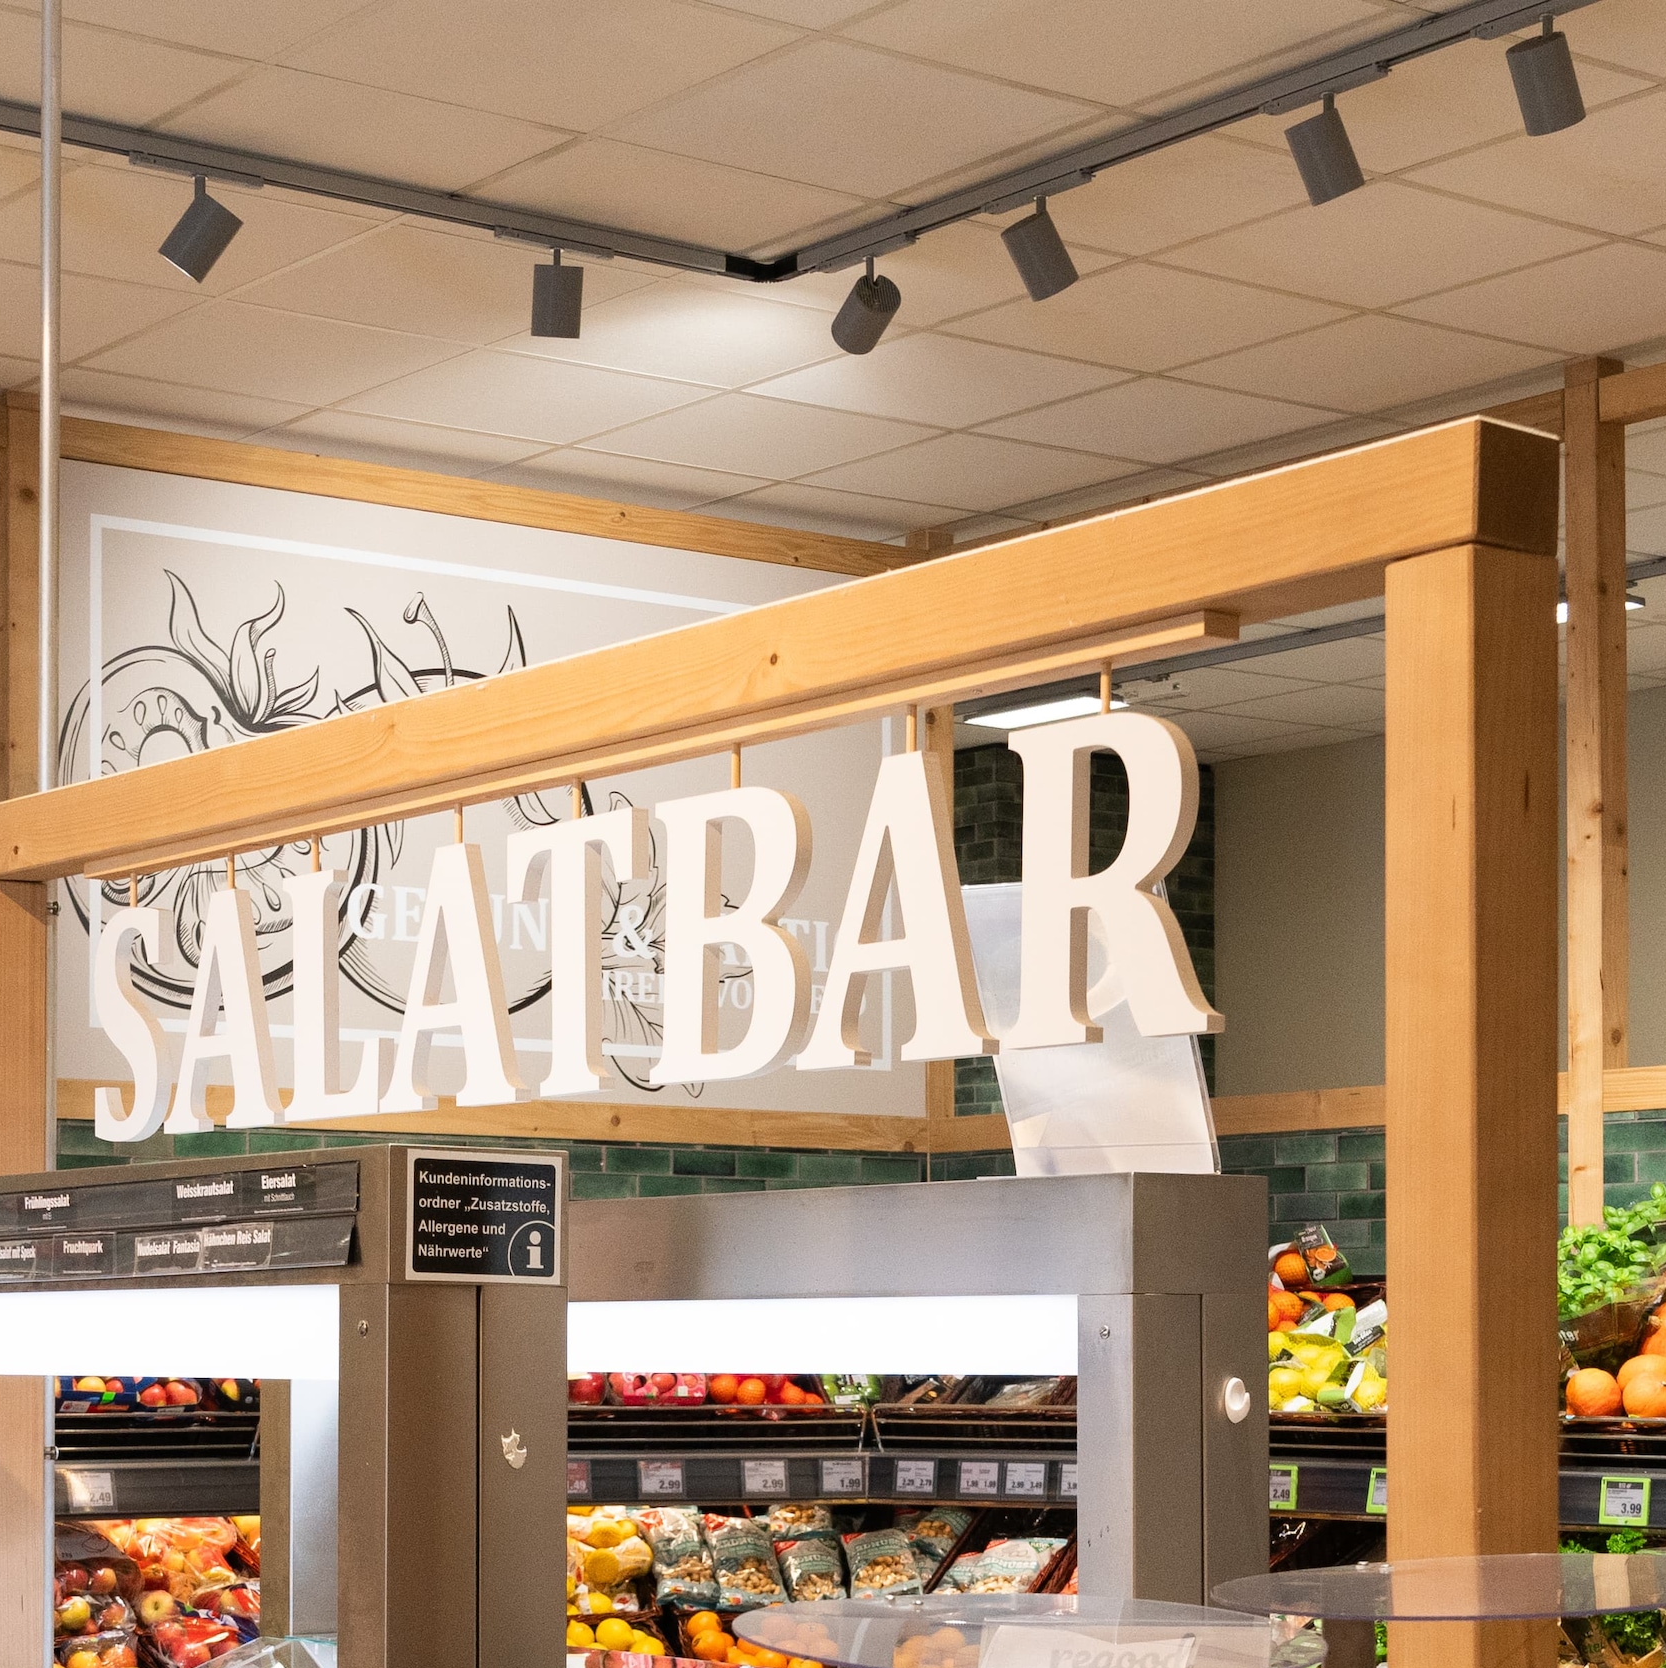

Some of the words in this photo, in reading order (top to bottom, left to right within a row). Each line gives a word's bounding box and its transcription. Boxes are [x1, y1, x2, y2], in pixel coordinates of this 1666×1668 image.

[93, 712, 1225, 1142] SALATBAR
[613, 905, 657, 959] &
[261, 1173, 296, 1190] Eiersalat
[419, 1170, 551, 1190] Kundeninformations-
[176, 1181, 234, 1199] Weisskrautsalat
[419, 1196, 461, 1209] ordner
[464, 1198, 550, 1215] „Zusatzstoffe,
[418, 1220, 479, 1236] Allergene
[482, 1223, 506, 1235] und
[236, 1229, 252, 1245] Reis
[253, 1228, 271, 1243] Salat
[63, 1240, 103, 1256] Fruchtquark
[659, 1480, 680, 1490] 2.99
[762, 1479, 784, 1489] 2.99
[840, 1478, 861, 1489] 1.99
[1273, 1488, 1290, 1499] 2.49
[1621, 1503, 1642, 1515] 3.99
